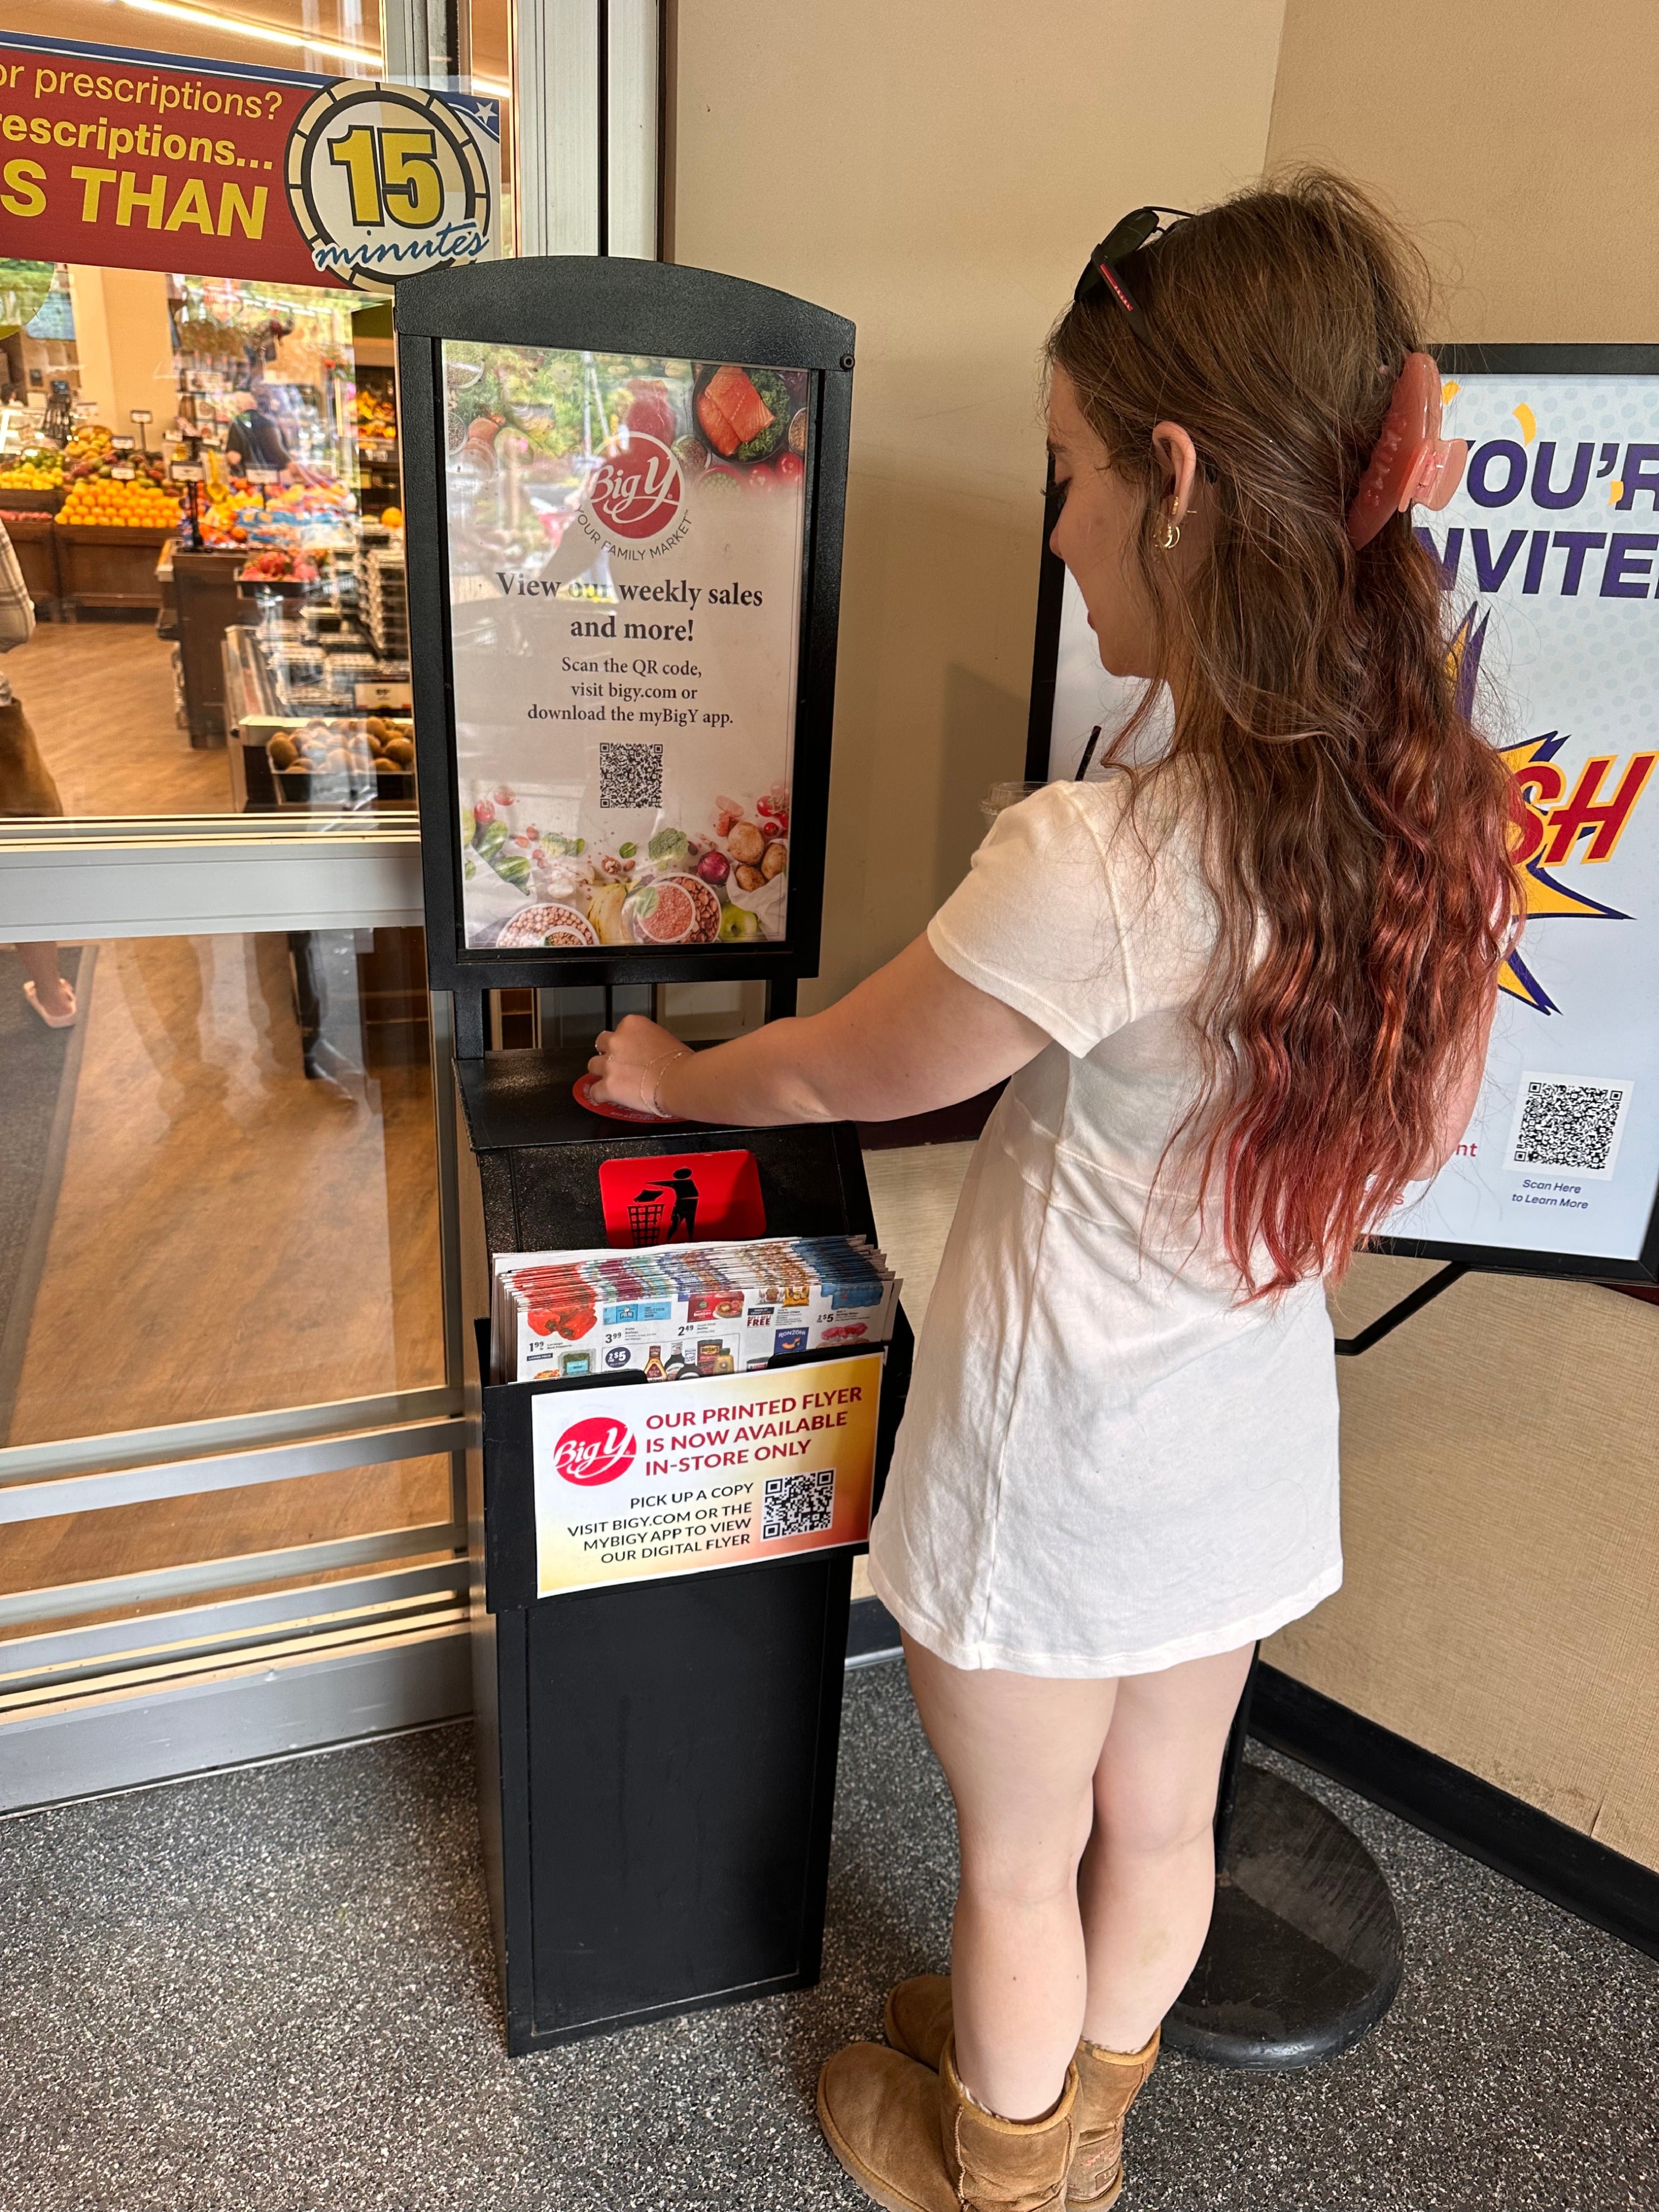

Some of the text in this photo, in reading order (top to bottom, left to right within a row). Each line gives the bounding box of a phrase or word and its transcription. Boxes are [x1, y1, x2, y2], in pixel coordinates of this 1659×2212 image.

[35, 68, 283, 120] prescriptions?
[0, 114, 273, 170] escriptions...
[327, 125, 445, 229] 15
[71, 165, 268, 240] THAN
[315, 222, 489, 268] minutes
[588, 464, 642, 515] Big
[1466, 439, 1659, 511] OU'R
[574, 504, 601, 545] YOUR
[601, 540, 646, 561] FAMILY
[495, 572, 763, 611] View our weekly sales
[571, 616, 693, 641] and more!
[562, 657, 702, 678] Scan the QR code,
[571, 682, 698, 702] visit bigy.com or
[528, 704, 733, 728] download the myBigY app.
[1512, 1194, 1588, 1209] to Learn More
[1522, 1179, 1581, 1193] Scan Here
[747, 1318, 771, 1327] FREE
[778, 1329, 806, 1338] RONZONI
[646, 1386, 862, 1430] OUR PRINTED FLYER
[646, 1411, 848, 1453] IS NOW AVAILABLE
[554, 1440, 602, 1473] Big
[646, 1439, 811, 1476] IN-STORE ONLY
[630, 1482, 754, 1509] PICK UP A COPY
[567, 1502, 752, 1537] VISIT BIGY.COM OR THE
[584, 1518, 752, 1551] MYBIGY APP TO VIEW
[601, 1534, 751, 1564] OUR DIGITAL FLYER
